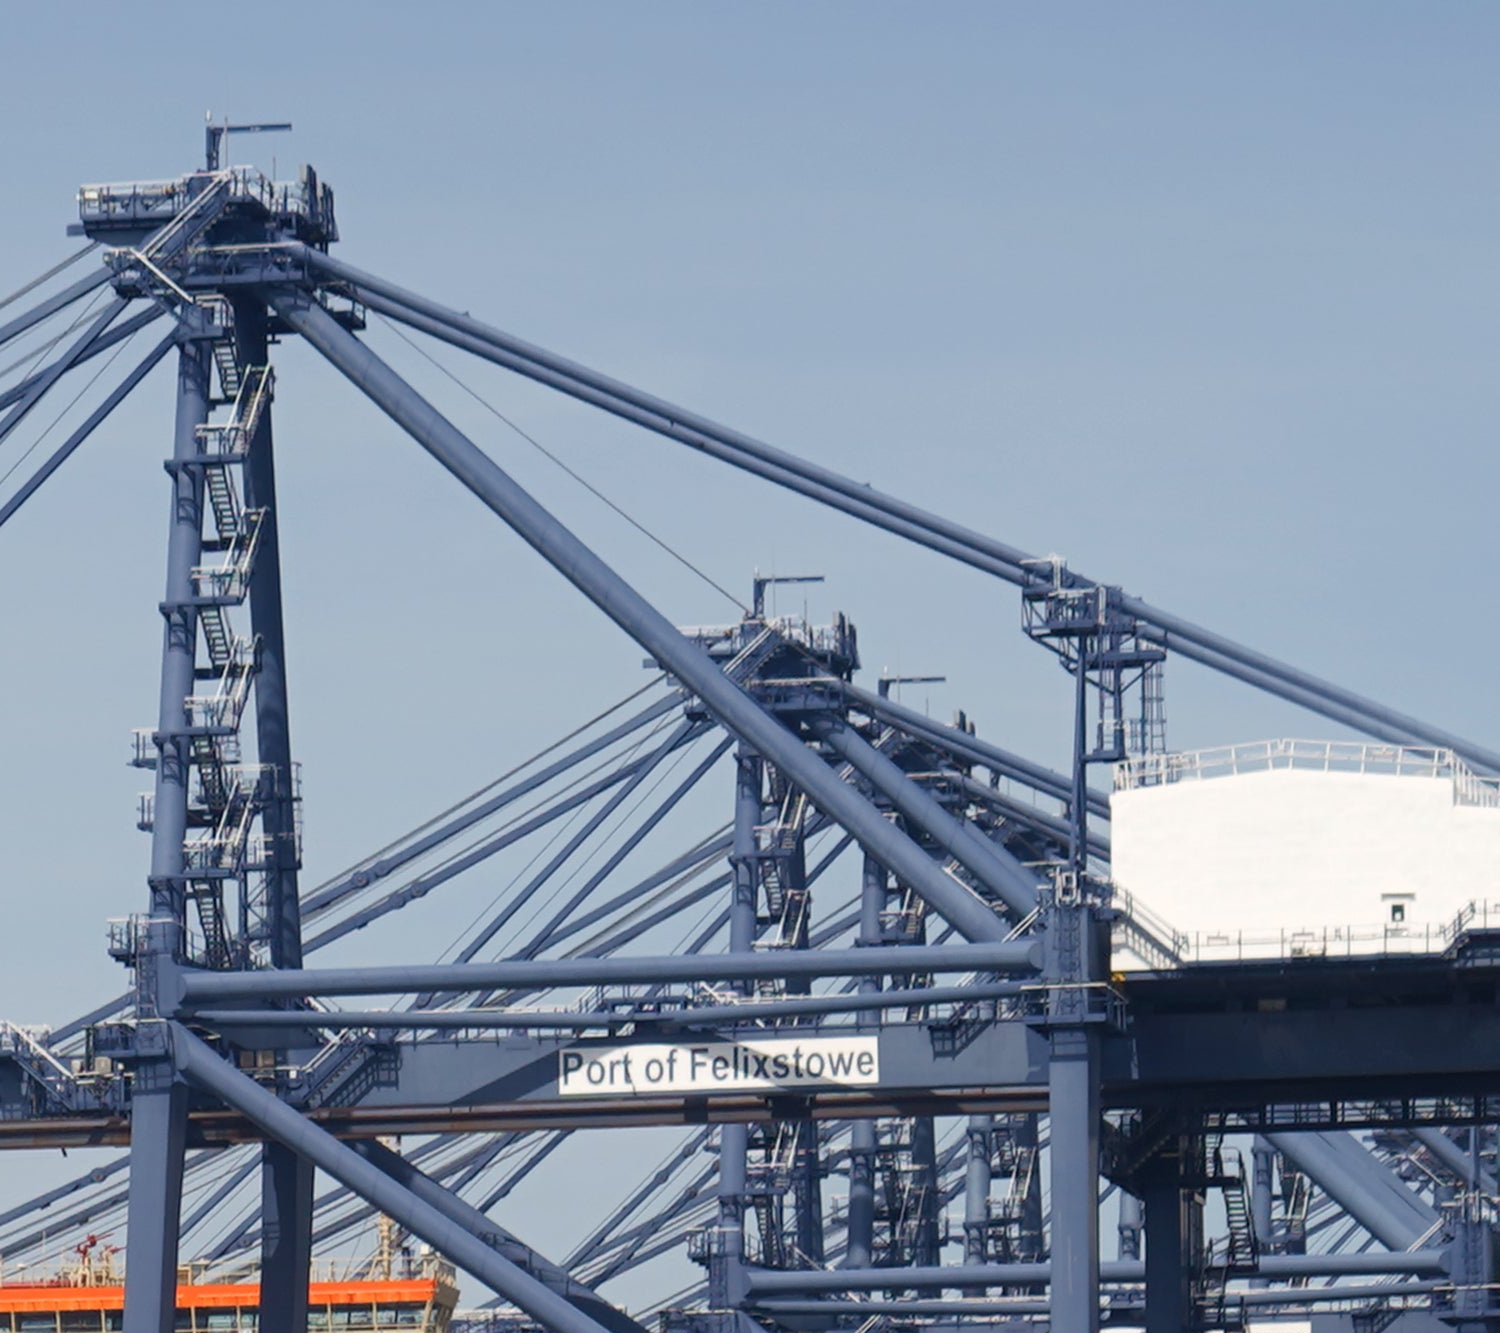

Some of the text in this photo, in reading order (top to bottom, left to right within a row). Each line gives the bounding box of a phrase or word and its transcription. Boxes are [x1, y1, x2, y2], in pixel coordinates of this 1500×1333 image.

[562, 1046, 874, 1085] Port of Felixstowe
